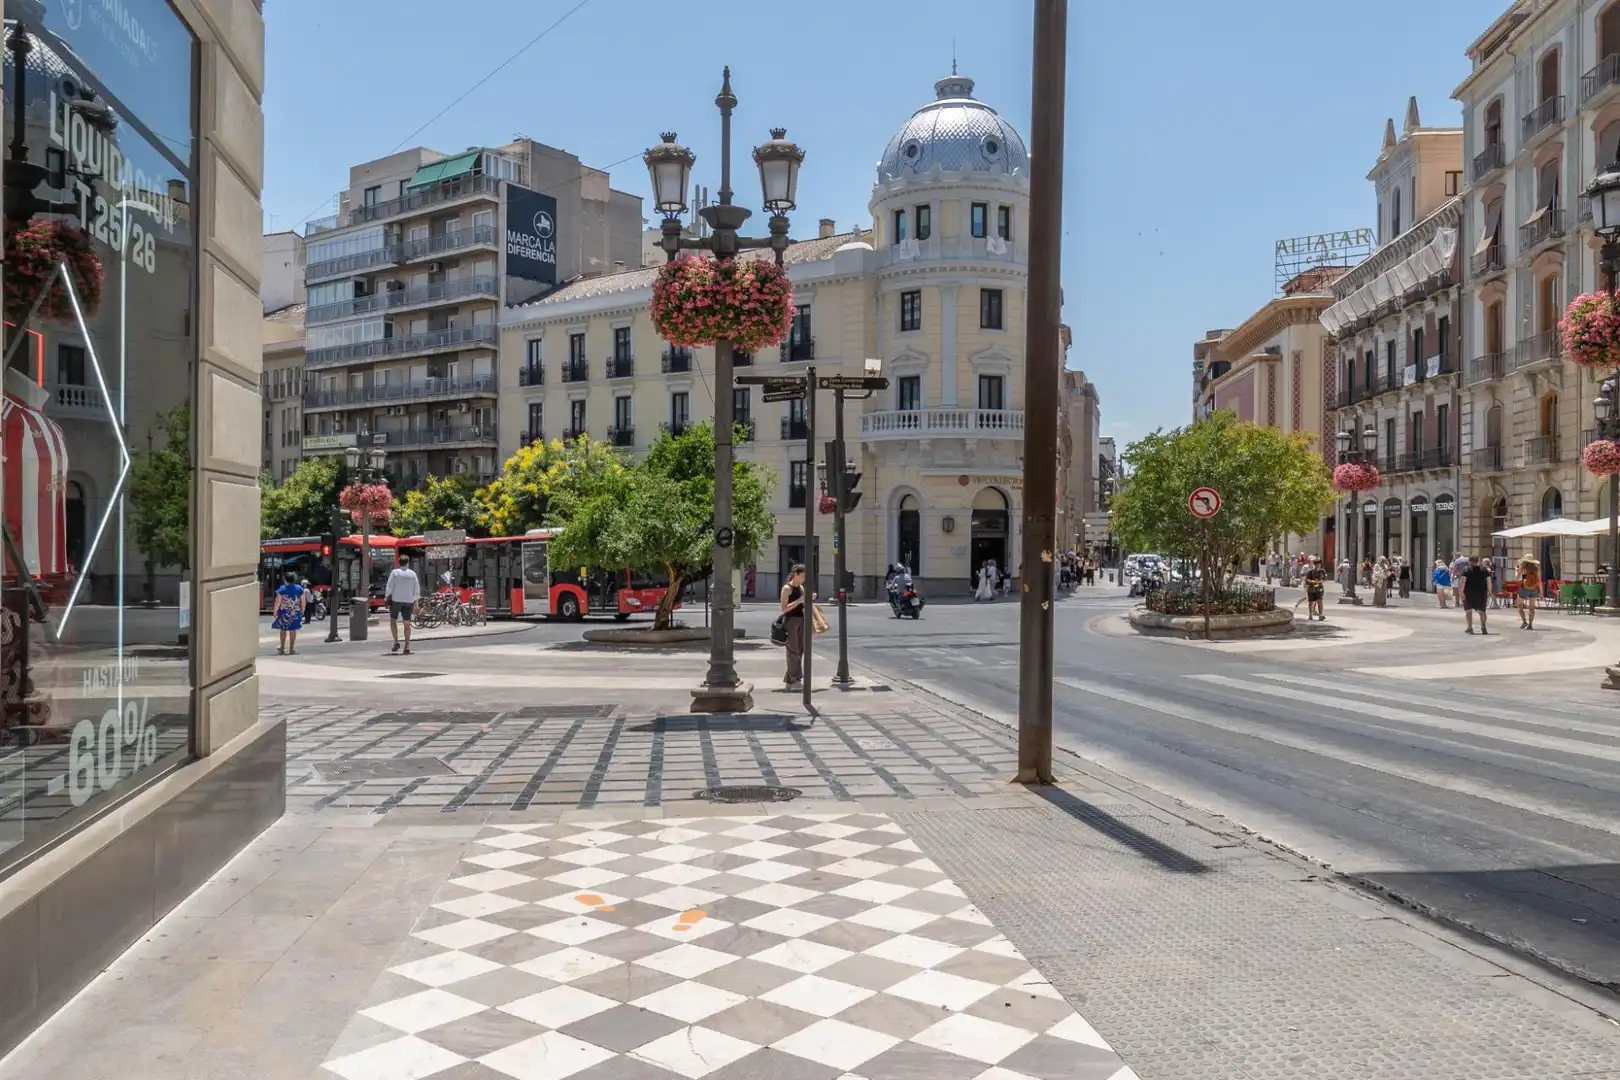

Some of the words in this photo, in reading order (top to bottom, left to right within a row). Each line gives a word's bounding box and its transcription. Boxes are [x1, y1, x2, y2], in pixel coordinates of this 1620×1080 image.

[76, 180, 156, 274] T.25/26
[507, 229, 541, 250] MARCA
[544, 239, 556, 253] LA
[1277, 229, 1369, 254] ALIATAR
[507, 243, 556, 264] DIFERENCIA
